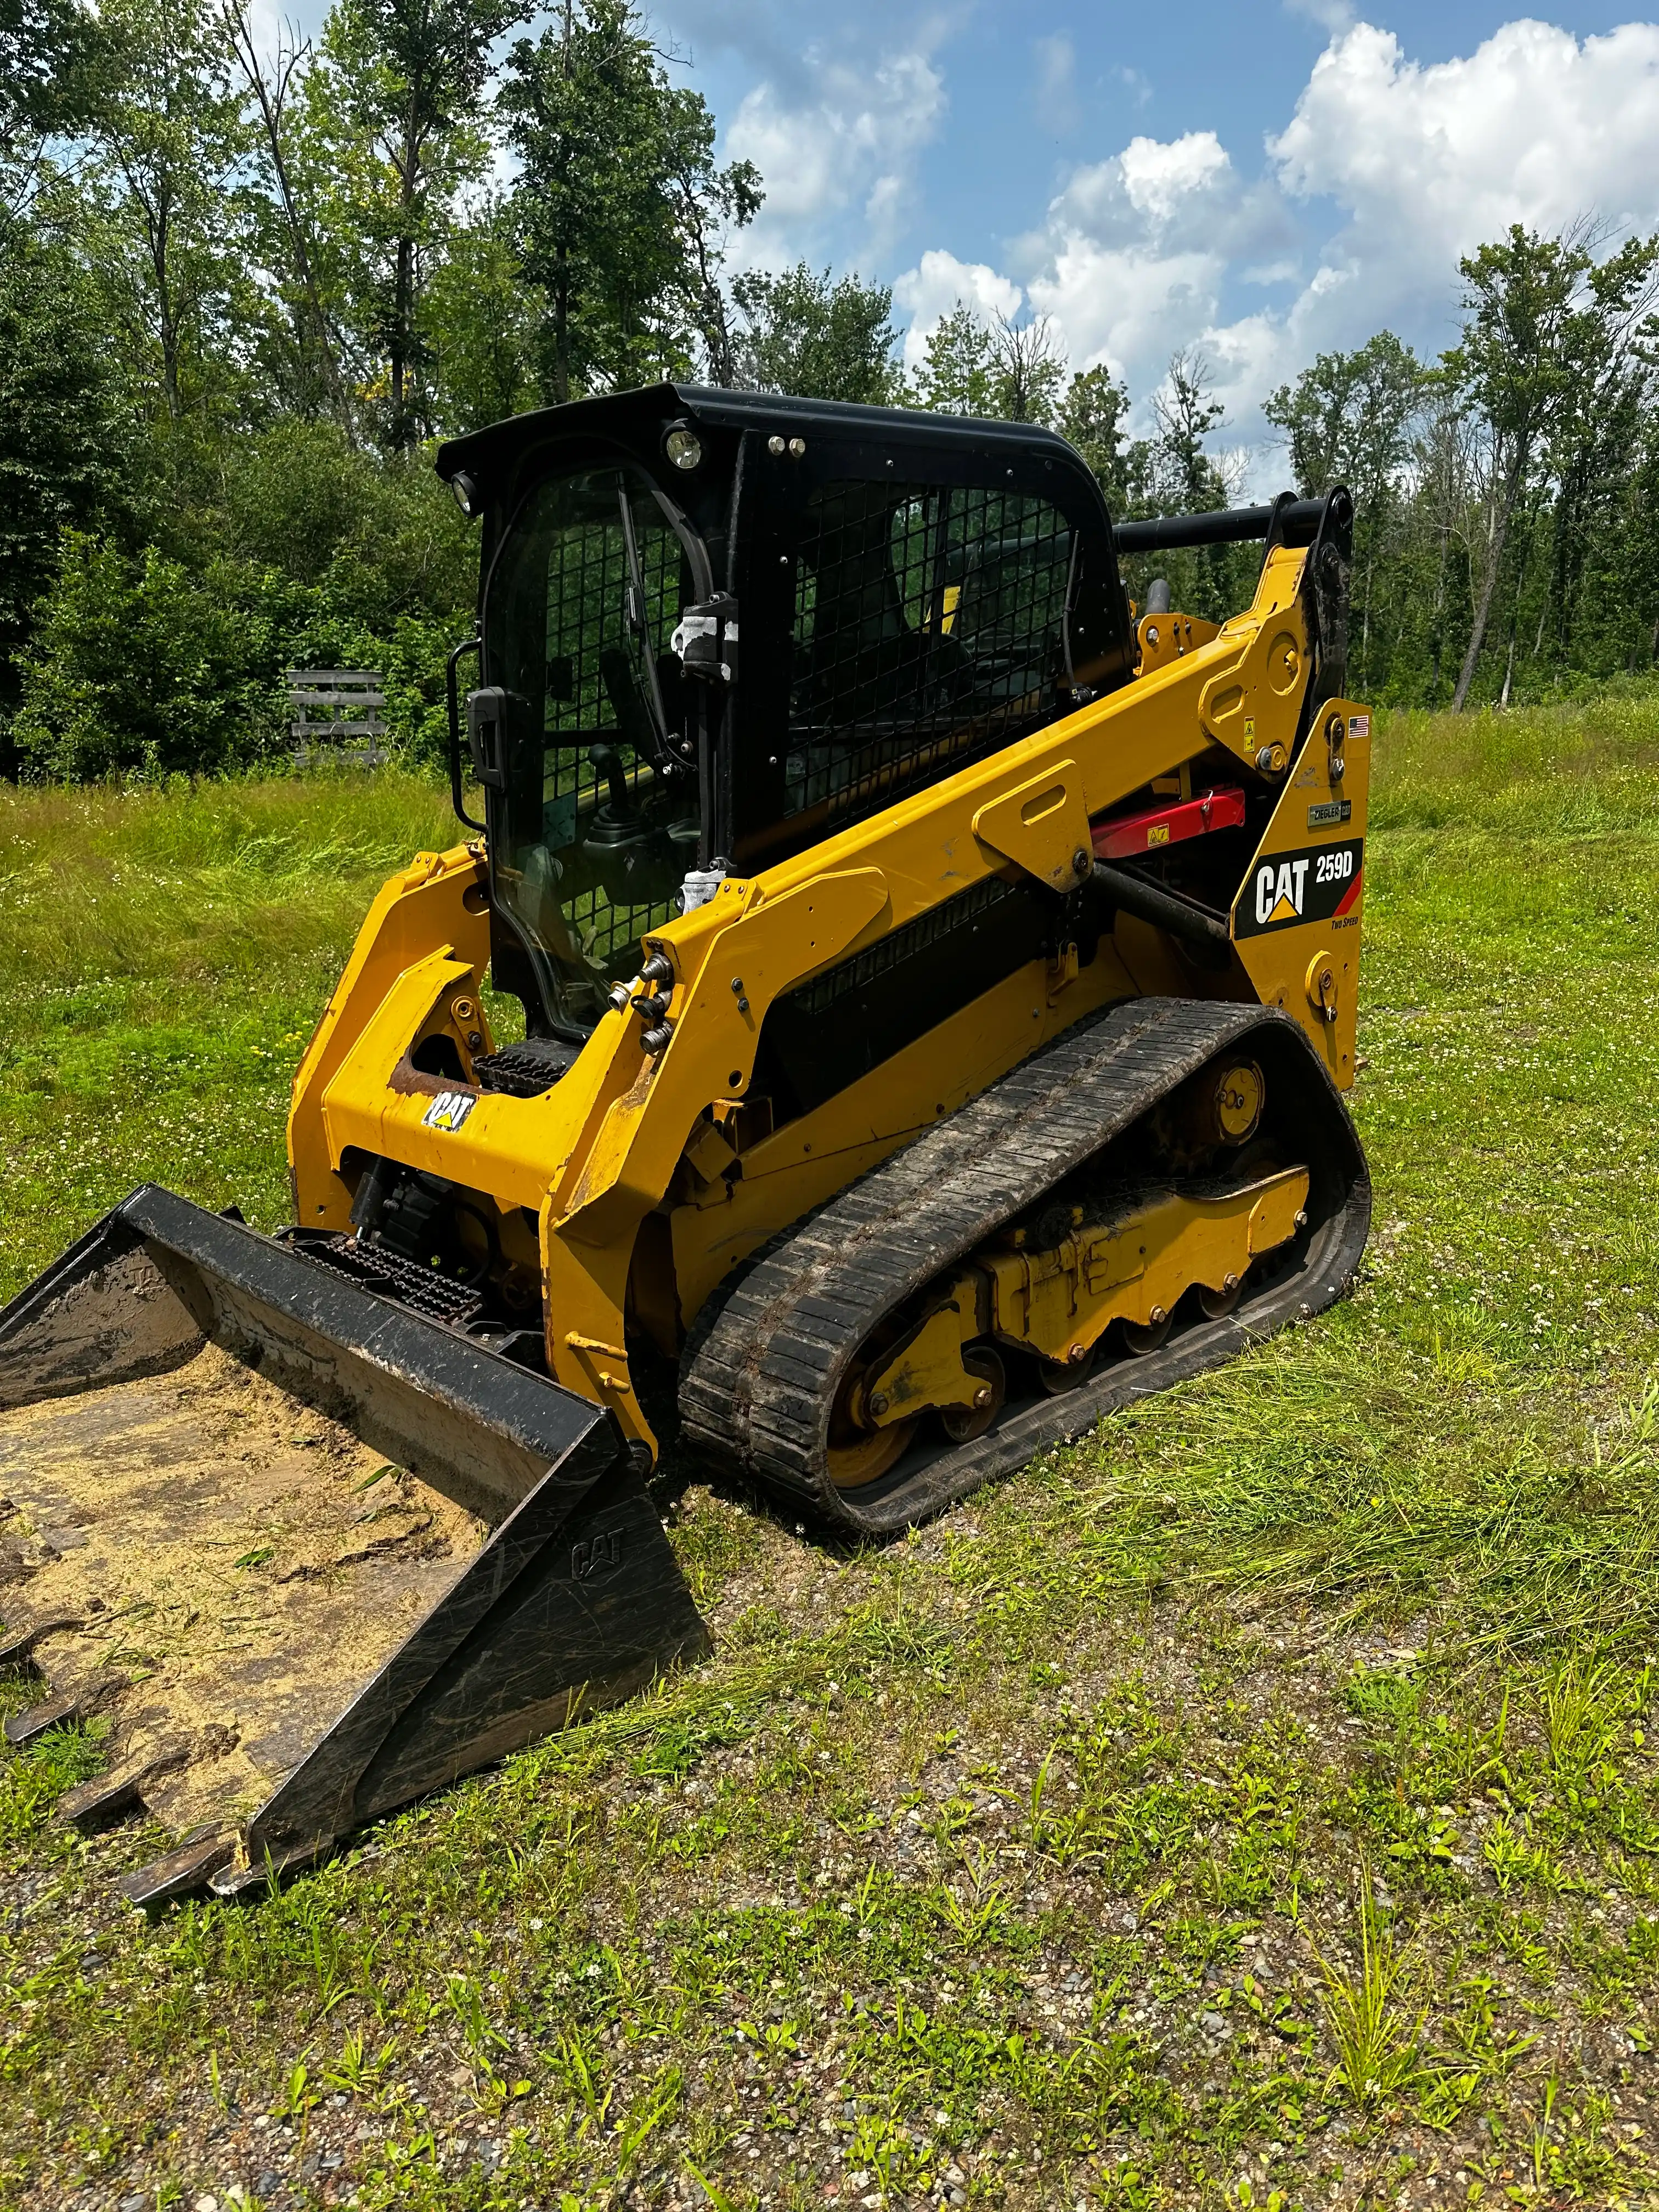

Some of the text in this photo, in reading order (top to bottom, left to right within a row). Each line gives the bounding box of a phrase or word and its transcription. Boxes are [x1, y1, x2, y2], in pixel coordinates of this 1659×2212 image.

[1314, 805, 1350, 820] ZIEGLER CAT
[1256, 851, 1352, 924] CAT 259D
[428, 1092, 474, 1128] CAT
[572, 1528, 624, 1580] CAT
